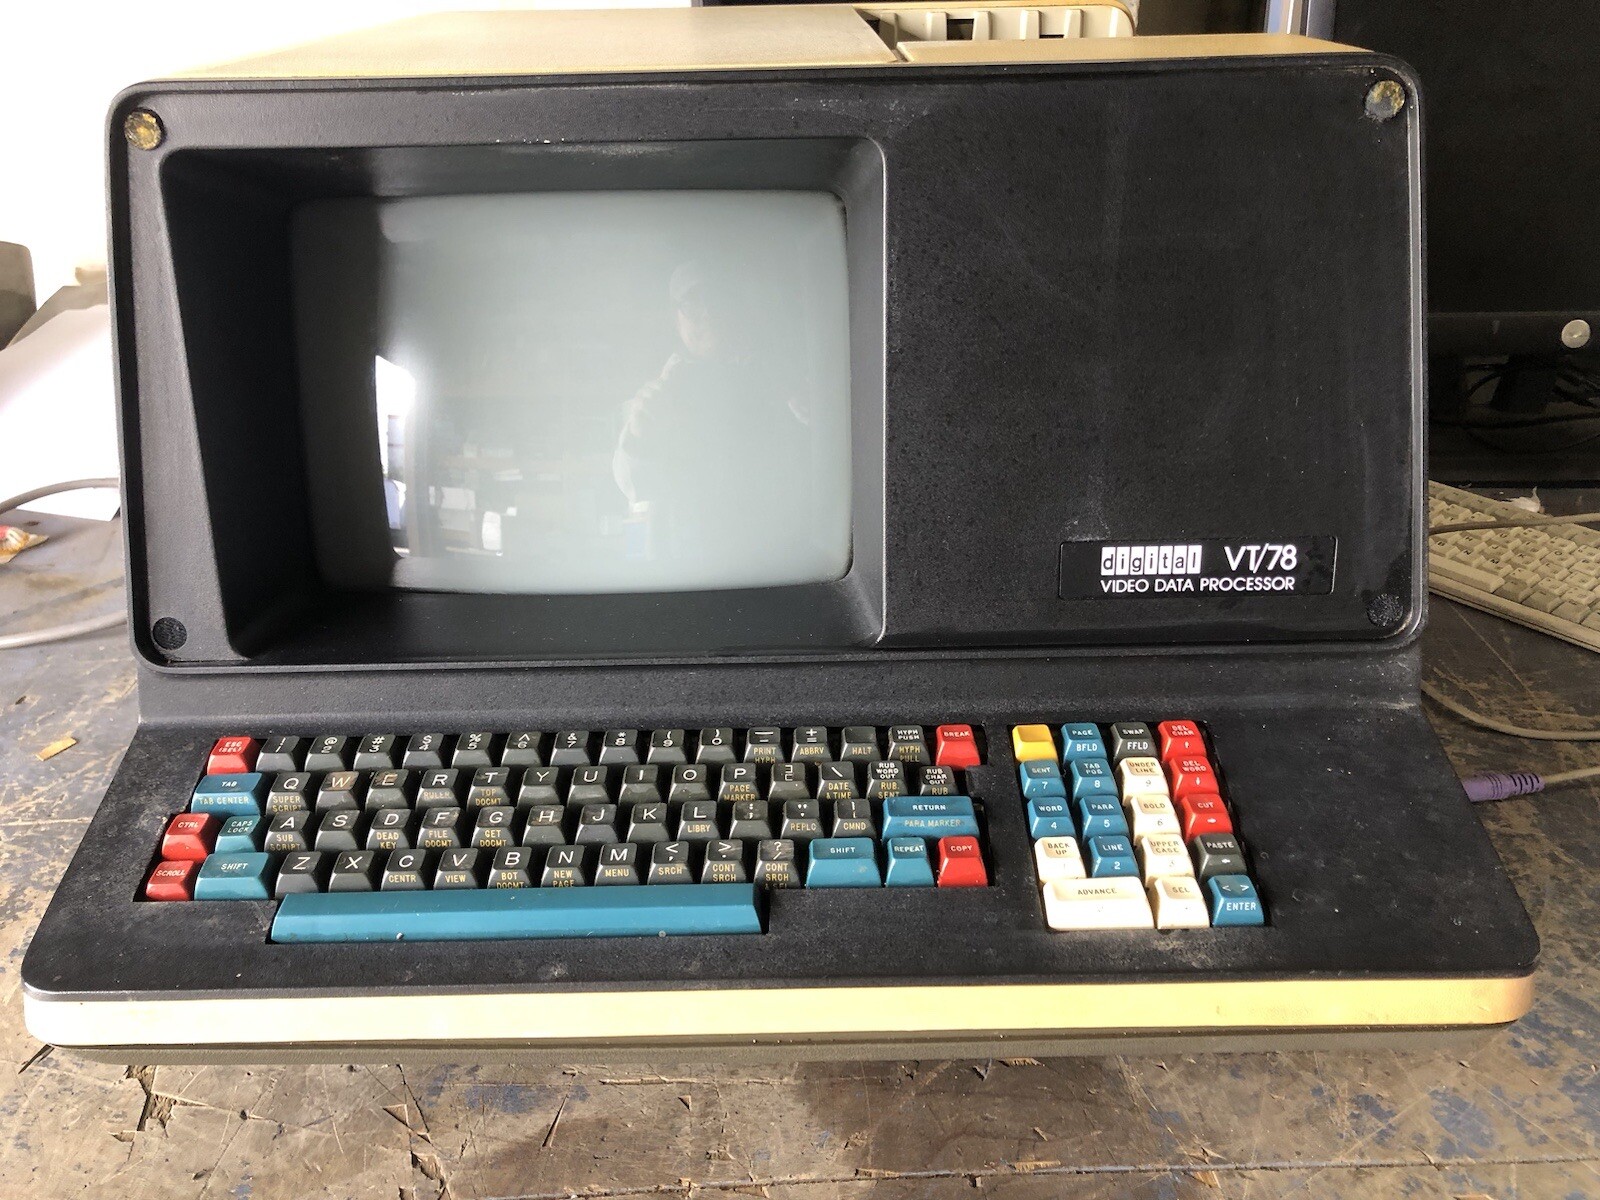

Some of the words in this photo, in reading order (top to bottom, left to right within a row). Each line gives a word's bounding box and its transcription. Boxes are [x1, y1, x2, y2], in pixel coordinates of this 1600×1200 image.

[1101, 545, 1202, 575] digital
[1224, 543, 1297, 573] VT/78
[1101, 579, 1149, 592] VIDEO
[1155, 579, 1194, 592] DATA
[1199, 577, 1295, 591] PROCESSOR
[567, 732, 577, 741] &
[805, 728, 818, 737] +
[943, 730, 971, 738] BREAK
[324, 736, 338, 746] @
[372, 736, 386, 744] #
[469, 733, 482, 743] %
[615, 737, 626, 746] 8
[467, 742, 478, 750] 5
[517, 741, 528, 749] 6
[567, 740, 577, 748] 7
[662, 739, 673, 747] 9
[1076, 743, 1098, 752] BFLD
[1127, 742, 1149, 750] FFLD
[321, 745, 333, 754] 2
[368, 744, 380, 753] 3
[753, 746, 777, 755] PRINT
[800, 747, 825, 755] ABBRV
[852, 746, 872, 755] HALT
[899, 746, 920, 754] HYPH
[485, 771, 498, 783] T
[536, 771, 549, 782] Y
[583, 770, 598, 782] U
[734, 768, 747, 779] P
[283, 777, 299, 790] Q
[331, 776, 351, 788] W
[382, 773, 398, 786] E
[432, 774, 448, 786] R
[1094, 779, 1101, 789] 8
[729, 784, 751, 793] PAGE
[1041, 781, 1048, 790] 7
[480, 788, 496, 797] TOP
[931, 786, 949, 795] RUB
[199, 796, 214, 805] TAB
[216, 795, 249, 804] CENTER
[272, 795, 300, 804] SUPER
[834, 791, 852, 800] TIME
[272, 804, 301, 812] SCRIPT
[693, 806, 707, 819] L
[434, 812, 450, 825] F
[489, 811, 503, 824] G
[538, 810, 555, 823] H
[592, 808, 605, 821] J
[642, 808, 657, 820] K
[231, 820, 253, 828] CAPS
[280, 816, 295, 829] A
[332, 814, 348, 828] S
[383, 813, 399, 826] D
[904, 819, 926, 827] PARA
[927, 819, 961, 827] MARKER
[1103, 819, 1111, 828] 5
[687, 824, 711, 833] LIBRY
[790, 823, 817, 831] REPLC
[843, 822, 867, 831] CMND
[1050, 821, 1057, 830] 4
[276, 834, 294, 842] SUB
[376, 832, 399, 840] DEAD
[428, 830, 448, 838] FILE
[484, 829, 501, 838] GET
[270, 843, 300, 851] SCRIPT
[380, 841, 397, 849] KEY
[773, 841, 782, 851] ?
[1206, 841, 1235, 849] PASTE
[504, 851, 521, 866] B
[558, 850, 574, 864] N
[609, 848, 628, 861] M
[292, 856, 311, 870] Z
[344, 856, 363, 869] X
[398, 854, 414, 868] C
[452, 853, 468, 867] V
[712, 863, 736, 872] CONT
[765, 862, 789, 872] CONT
[1113, 861, 1121, 870] 2
[156, 869, 187, 877] SCROLL
[501, 871, 518, 880] BOT
[553, 870, 573, 879] NEW
[605, 868, 629, 877] MENU
[657, 866, 683, 876] SRCH
[388, 874, 417, 883] CENTR
[444, 874, 466, 883] VIEW
[712, 873, 737, 882] SRCH
[765, 873, 789, 882] SRCH
[1226, 902, 1257, 911] ENTER
